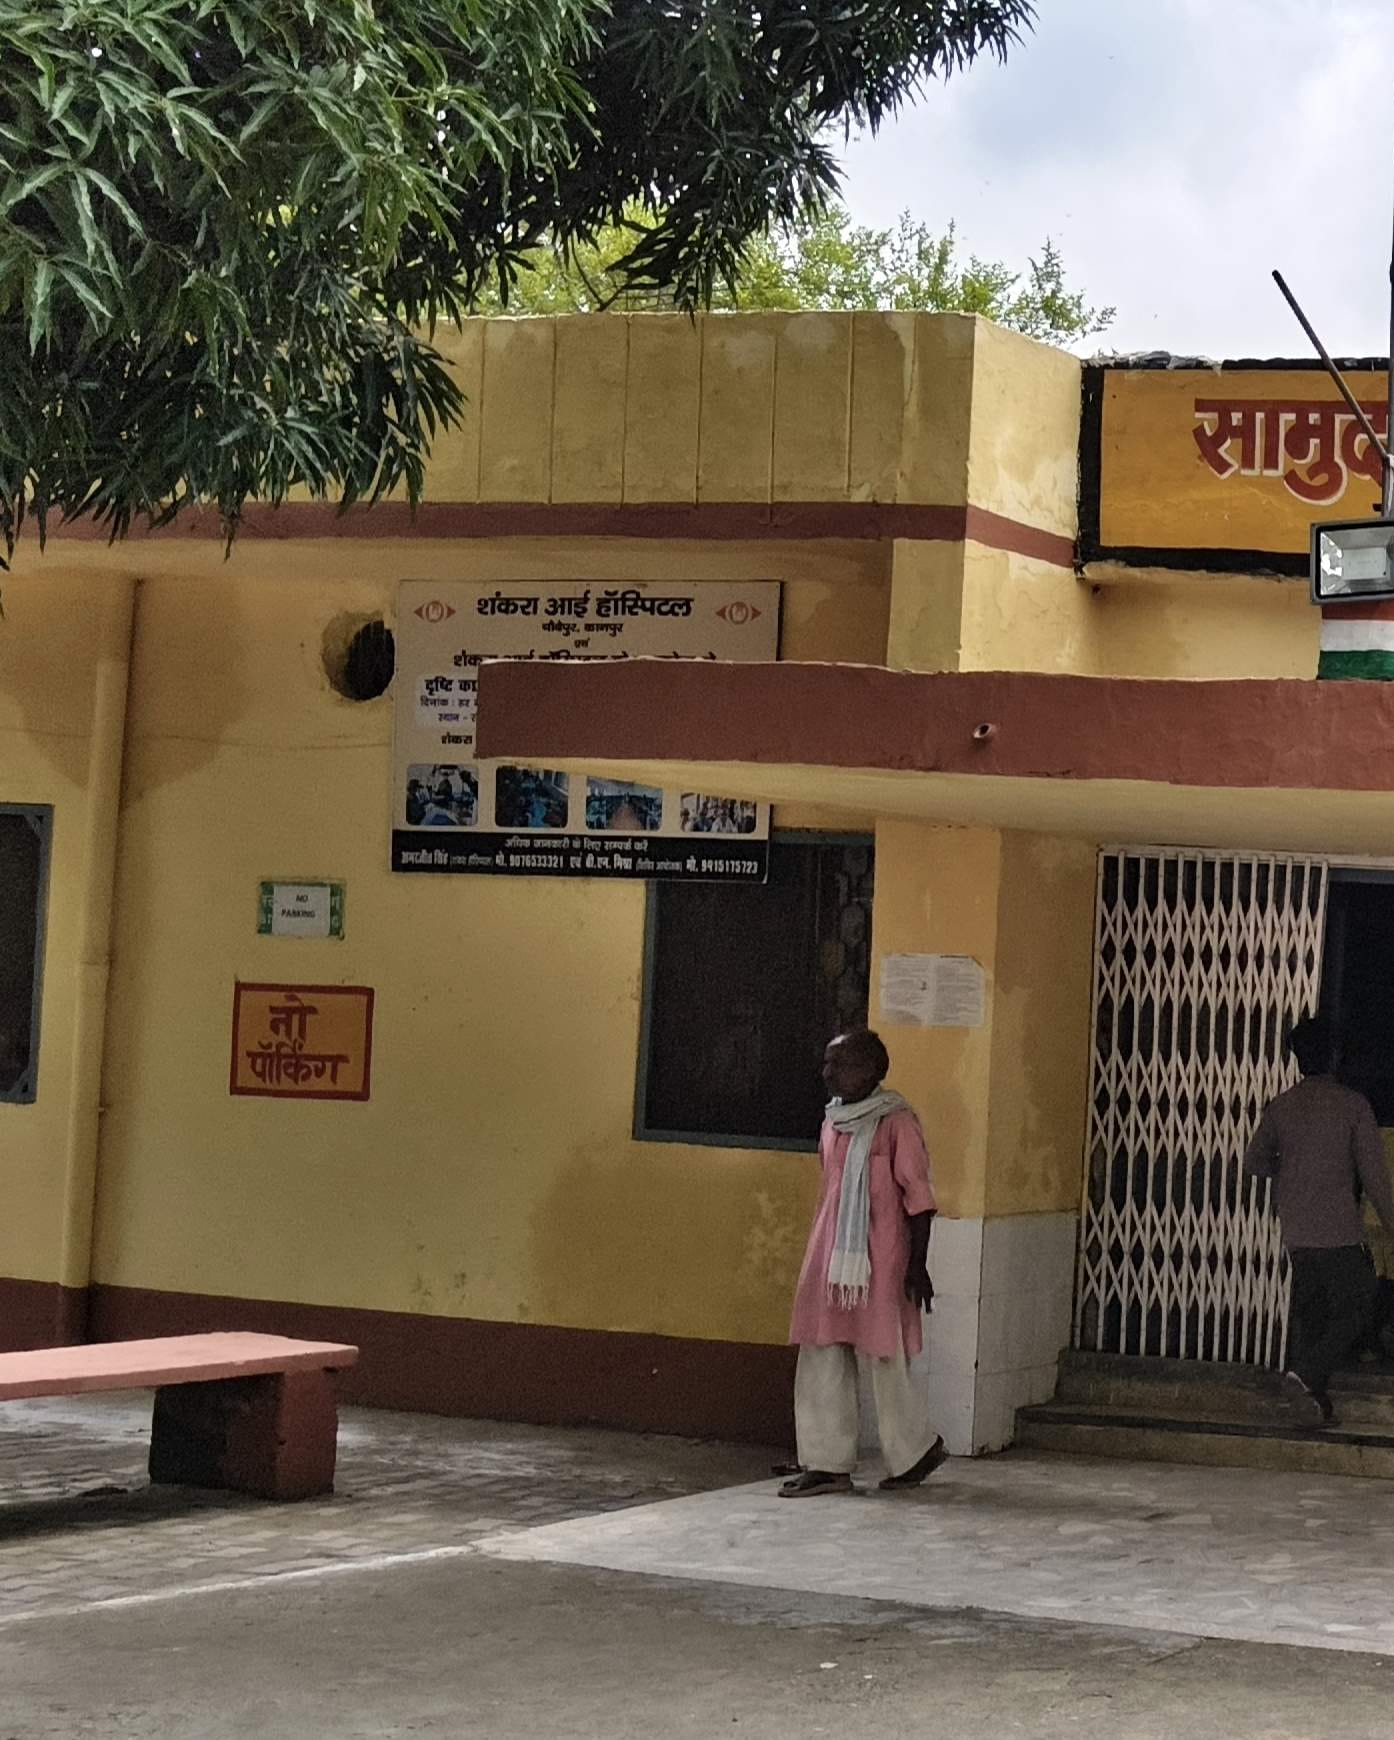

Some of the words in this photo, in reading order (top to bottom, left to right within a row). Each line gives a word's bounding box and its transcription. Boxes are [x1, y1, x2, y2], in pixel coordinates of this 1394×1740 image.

[477, 590, 538, 616] शंकरा
[544, 589, 591, 618] आई
[595, 590, 695, 617] हॉस्पिटल
